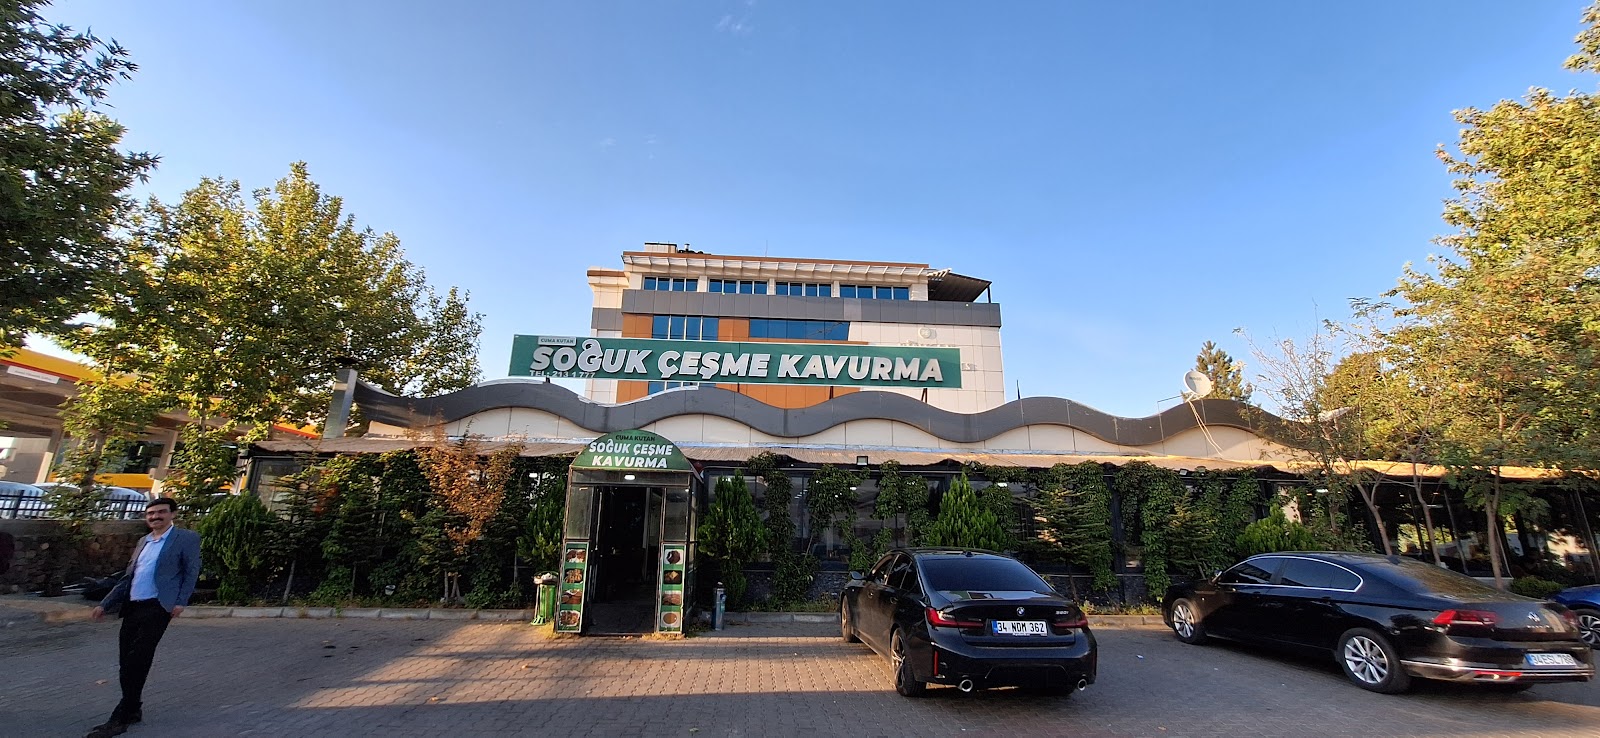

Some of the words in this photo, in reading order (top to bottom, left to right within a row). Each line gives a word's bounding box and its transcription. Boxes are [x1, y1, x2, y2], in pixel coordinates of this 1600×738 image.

[530, 339, 652, 373] SOĞUK
[657, 350, 770, 379] ÇEŞME
[778, 353, 944, 382] KAVURMA
[529, 370, 550, 378] TEL:
[579, 371, 596, 379] 777
[588, 439, 631, 454] SOĞUK
[633, 443, 674, 456] ÇEŞME
[592, 455, 668, 469] KAVURMA
[997, 622, 1008, 632] 34
[1029, 622, 1045, 633] 362
